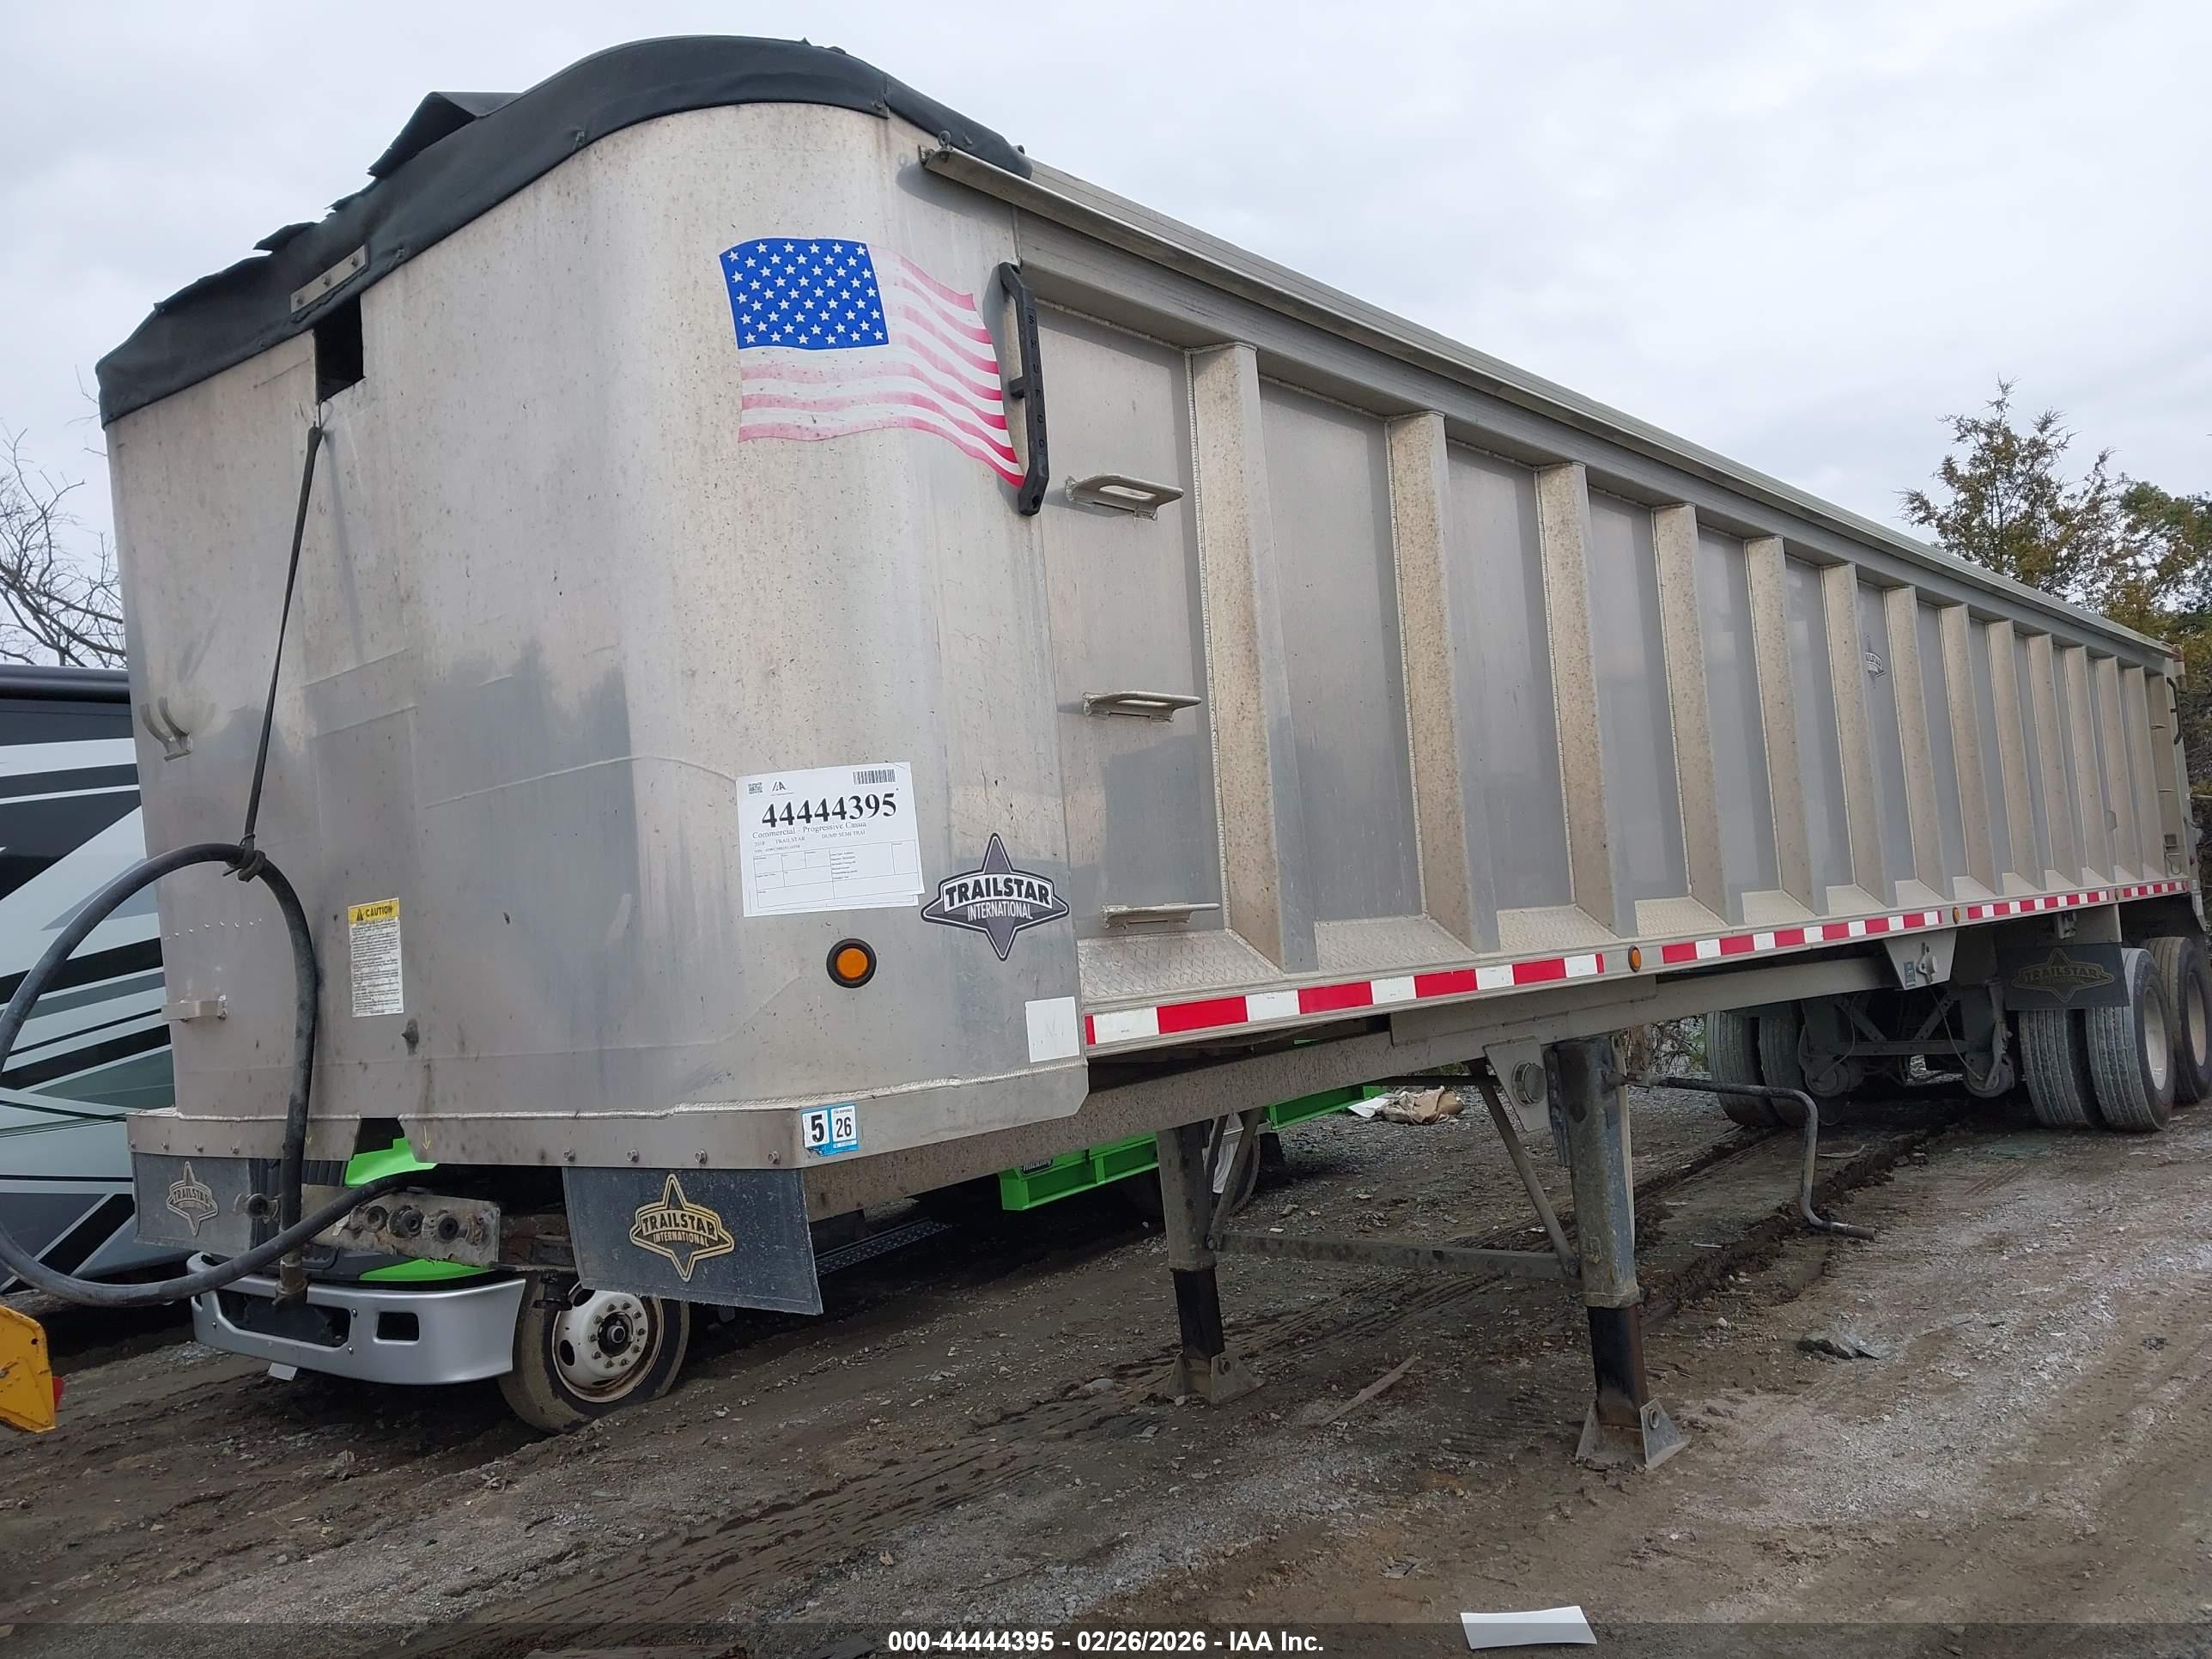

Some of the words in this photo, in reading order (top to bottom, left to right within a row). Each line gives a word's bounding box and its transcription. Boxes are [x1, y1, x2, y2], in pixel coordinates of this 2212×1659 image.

[762, 792, 897, 828] 44444395
[752, 828, 796, 839] Commercial
[803, 823, 843, 834] Progressive
[945, 877, 1050, 908] TRAILSTAR
[365, 905, 392, 918] CAUTION
[967, 901, 1034, 922] INTERNATIONAL
[2024, 967, 2097, 982] TRAILSTAR
[810, 1114, 824, 1143] 5
[836, 1116, 852, 1139] 26
[642, 1212, 715, 1238] TRAILSTAR
[653, 1231, 710, 1248] INTERNATIONAL
